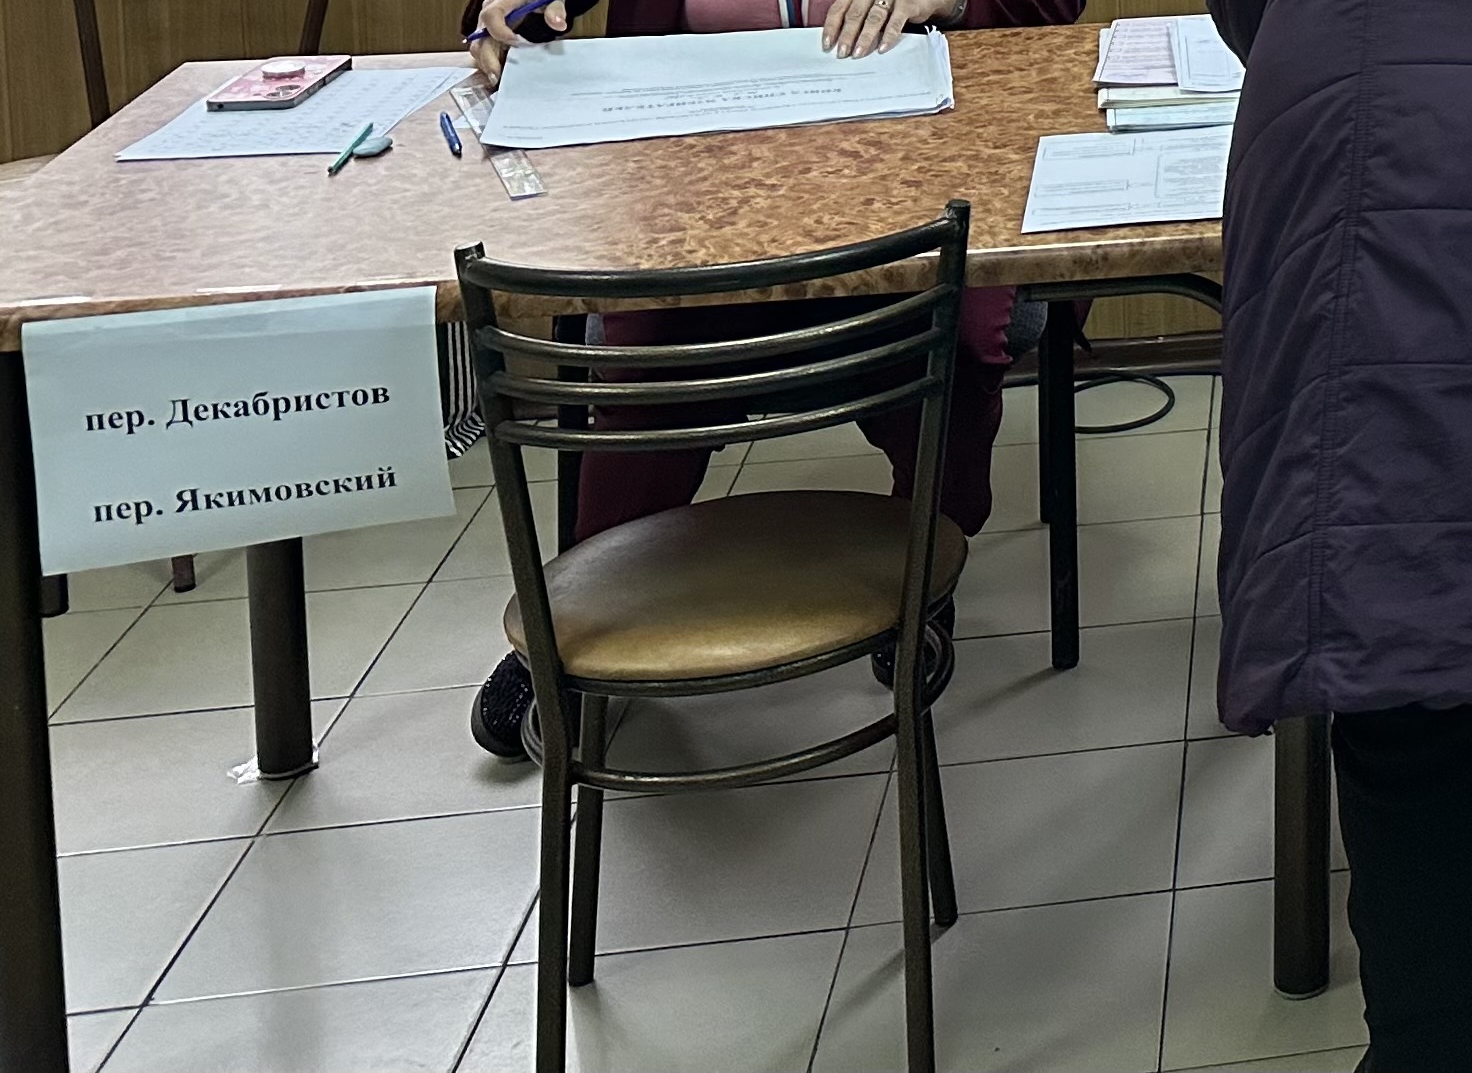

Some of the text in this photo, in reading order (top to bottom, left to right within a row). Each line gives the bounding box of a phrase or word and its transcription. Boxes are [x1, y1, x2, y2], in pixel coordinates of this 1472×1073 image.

[86, 387, 391, 435] пер. Декабристов
[94, 466, 398, 526] пер. Якимовский
